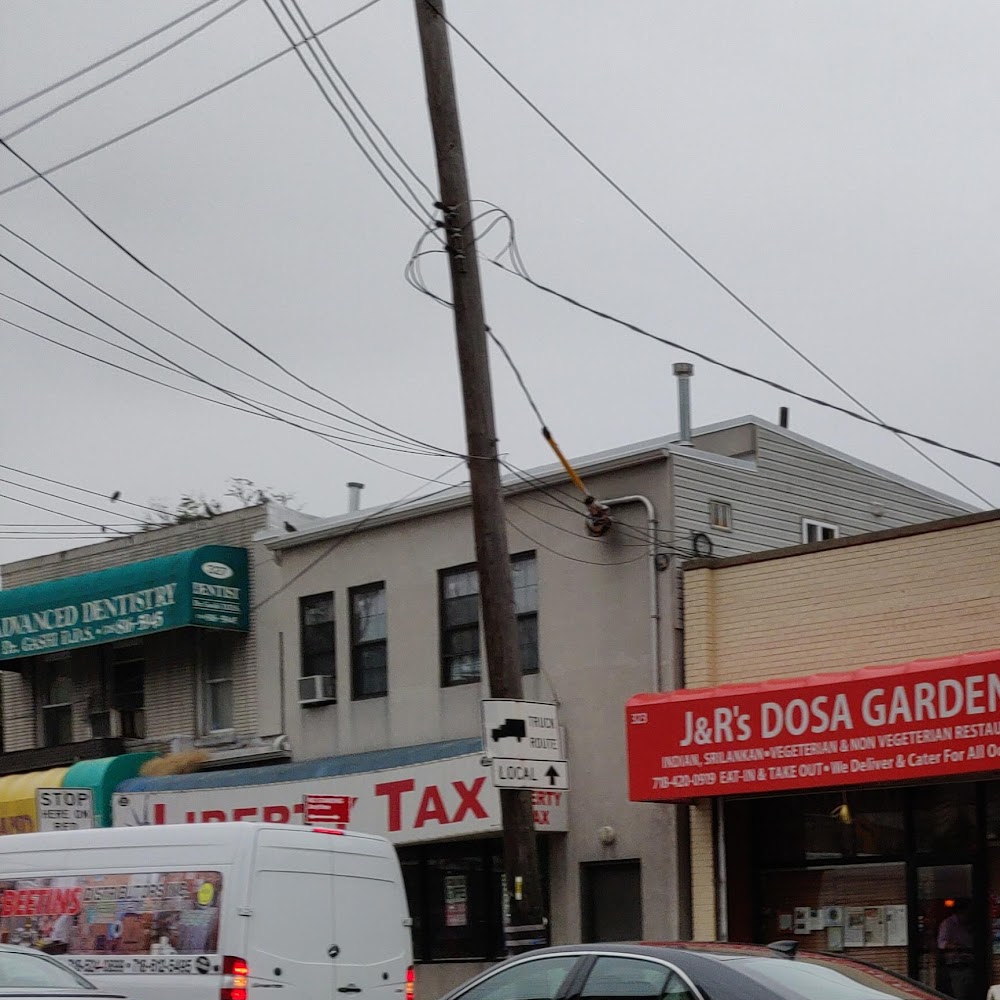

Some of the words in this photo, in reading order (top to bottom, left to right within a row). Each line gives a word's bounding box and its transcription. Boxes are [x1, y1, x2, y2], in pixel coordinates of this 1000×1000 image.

[192, 582, 241, 599] DENTIST
[0, 605, 79, 637] DVANCED
[81, 583, 177, 623] DENTISTRY
[528, 716, 555, 729] TRUCK
[631, 713, 648, 725] 323
[680, 705, 751, 747] J&R's
[760, 693, 853, 739] DOSA
[529, 738, 558, 750] ROUTE
[839, 739, 848, 753] &
[850, 735, 876, 751] NON
[878, 727, 951, 749] VEGETERIAN
[719, 769, 756, 785] EAT-IN
[757, 768, 767, 782] &
[768, 765, 797, 780] TAKE
[798, 762, 823, 778] OUT
[830, 760, 848, 775] We
[850, 757, 894, 773] Deliver
[895, 754, 907, 769] &
[907, 751, 941, 768] Cater
[943, 748, 965, 763] For
[967, 745, 984, 760] All
[498, 765, 539, 781] LOCAL
[41, 792, 88, 806] STOP
[375, 776, 490, 833] TAX
[532, 791, 561, 806] ERTY
[42, 810, 71, 819] HERE
[75, 810, 89, 819] ON
[532, 811, 550, 825] AX
